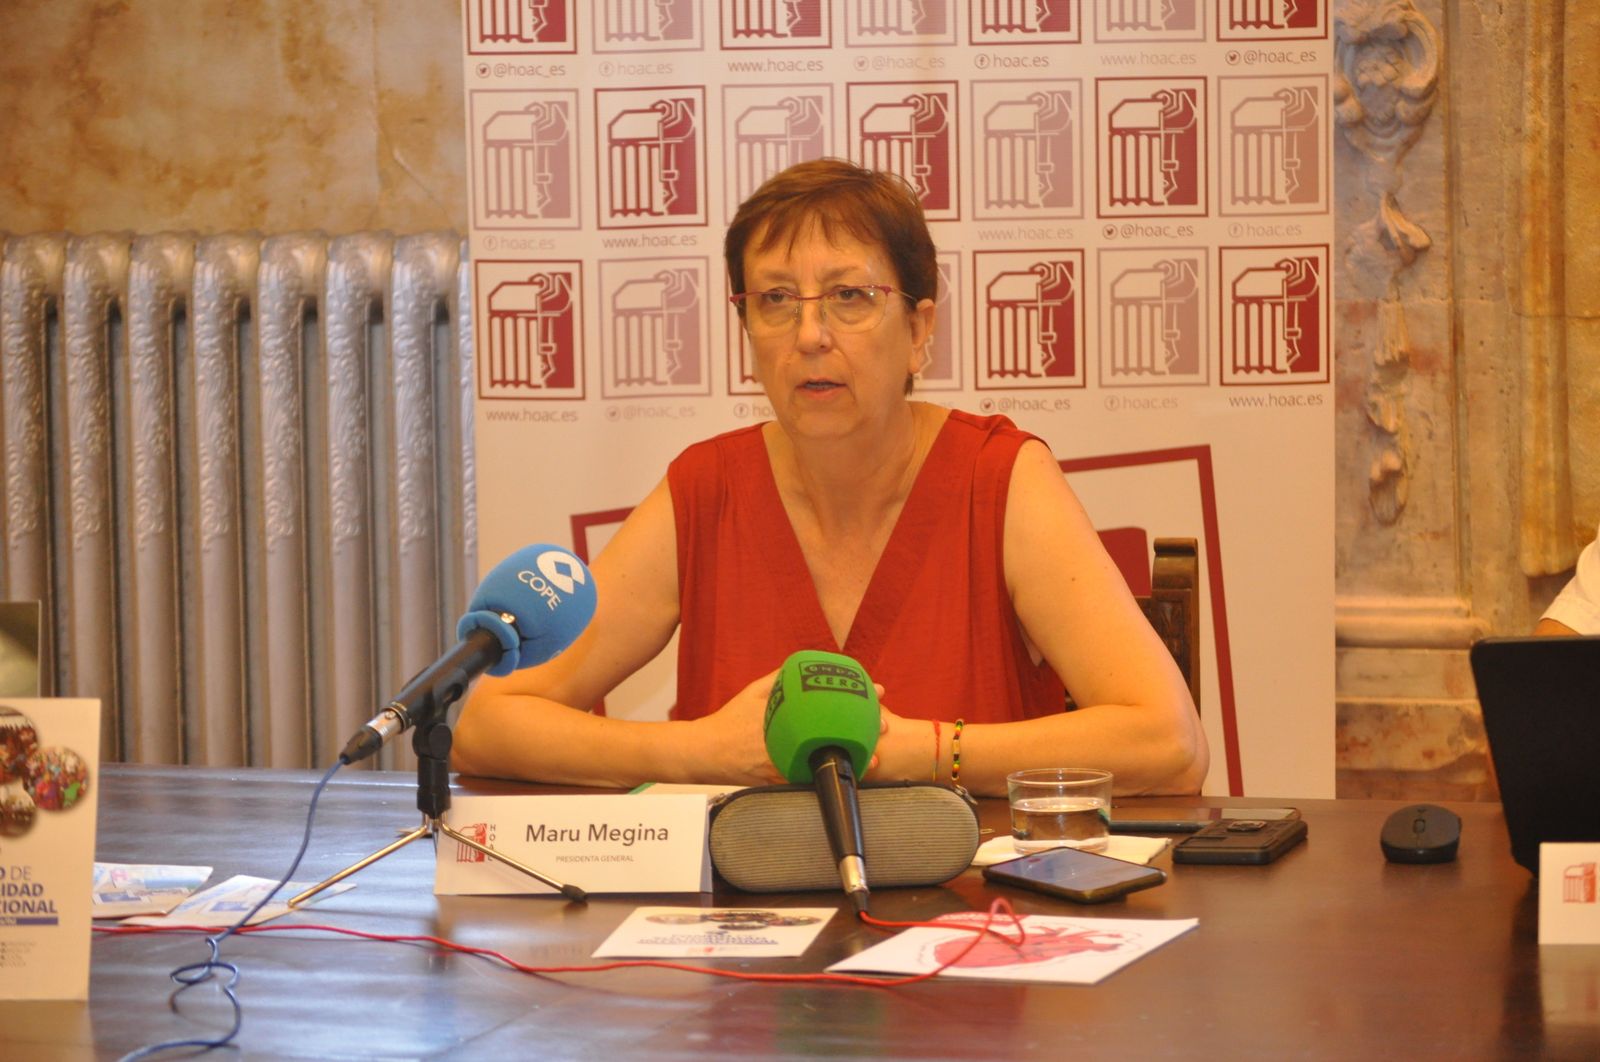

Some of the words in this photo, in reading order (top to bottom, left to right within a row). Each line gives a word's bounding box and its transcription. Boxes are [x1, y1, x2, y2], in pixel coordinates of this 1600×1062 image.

[727, 56, 824, 71] www.hoac.es
[871, 55, 945, 70] @hoac_es
[993, 53, 1049, 67] hoac.es
[1100, 51, 1197, 65] www.hoac.es
[1243, 49, 1317, 65] @hoac_es
[494, 62, 566, 77] @hoac_es
[617, 61, 673, 75] hoac.es
[978, 227, 1073, 241] www.hoac.es
[1120, 223, 1194, 239] @hoac_es
[1246, 222, 1302, 237] hoac.es
[500, 236, 555, 250] hoac.es
[602, 233, 697, 248] www.hoac.es
[998, 397, 1071, 413] @hoac_es
[1122, 394, 1178, 409] hoac.es
[1228, 393, 1324, 408] www.hoac.es
[486, 408, 578, 422] www.hoac.es
[623, 403, 696, 420] @hoac_es
[518, 570, 562, 611] COPE
[814, 677, 859, 689] CERO
[526, 824, 580, 842] Maru
[588, 823, 669, 846] Megina
[556, 855, 600, 864] PRESIDENTA
[600, 855, 634, 864] GENERAL
[11, 866, 32, 881] DE
[0, 883, 44, 897] IDAD
[0, 900, 58, 914] IONAL
